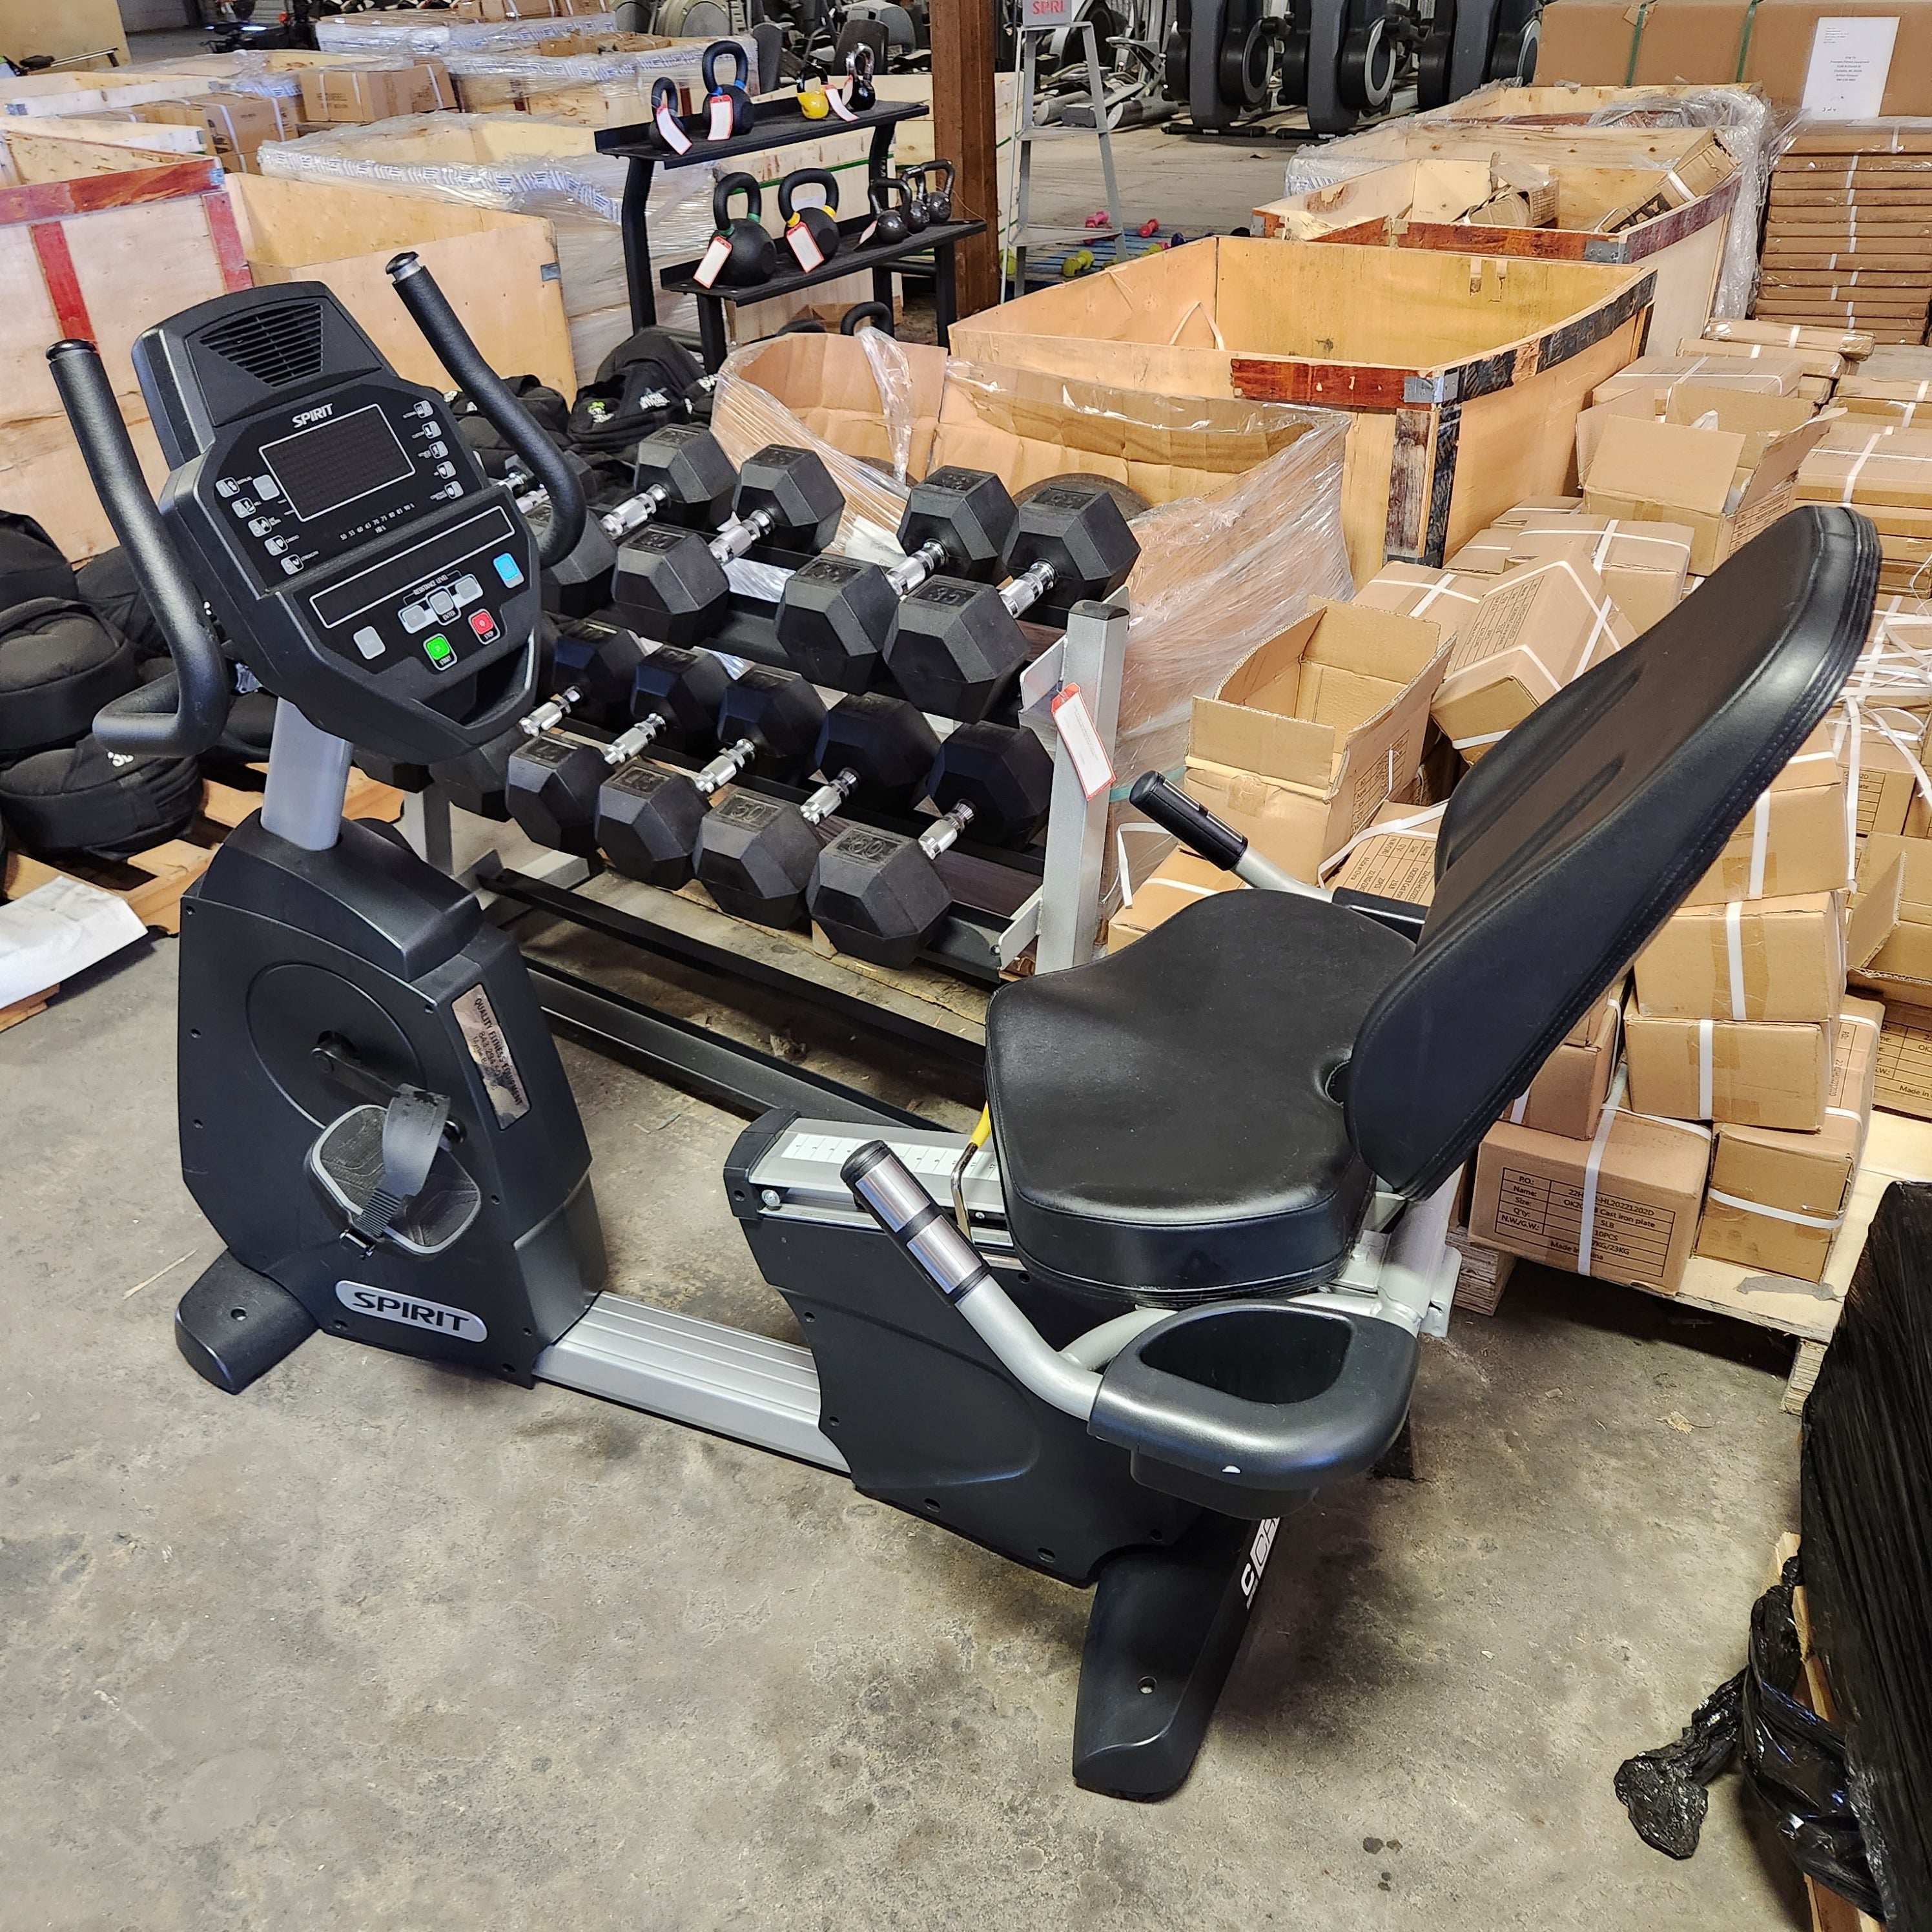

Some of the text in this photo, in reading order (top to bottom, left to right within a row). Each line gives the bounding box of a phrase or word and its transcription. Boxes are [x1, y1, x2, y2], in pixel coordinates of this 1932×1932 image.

[1033, 1, 1064, 14] SPRI
[291, 402, 333, 429] SPIRIT
[235, 504, 245, 515] 2
[412, 574, 449, 596] RESISTANCE LEVEL
[442, 610, 457, 621] ENTER
[483, 630, 495, 640] STOP
[439, 655, 452, 666] START
[474, 998, 523, 1105] QUALITY FITNESS EQUIPMENT
[1900, 1084, 1920, 1094] Made
[1513, 1185, 1537, 1197] Name:
[1515, 1197, 1532, 1208] Size:
[1513, 1207, 1531, 1218] Q'ty:
[1599, 1208, 1617, 1219] Cast
[1618, 1212, 1634, 1223] iron
[1635, 1216, 1656, 1228] plate
[1600, 1220, 1614, 1229] 5LB
[1595, 1229, 1619, 1242] 10PCS
[1550, 1240, 1572, 1252] Made
[351, 1291, 470, 1331] SPIRIT
